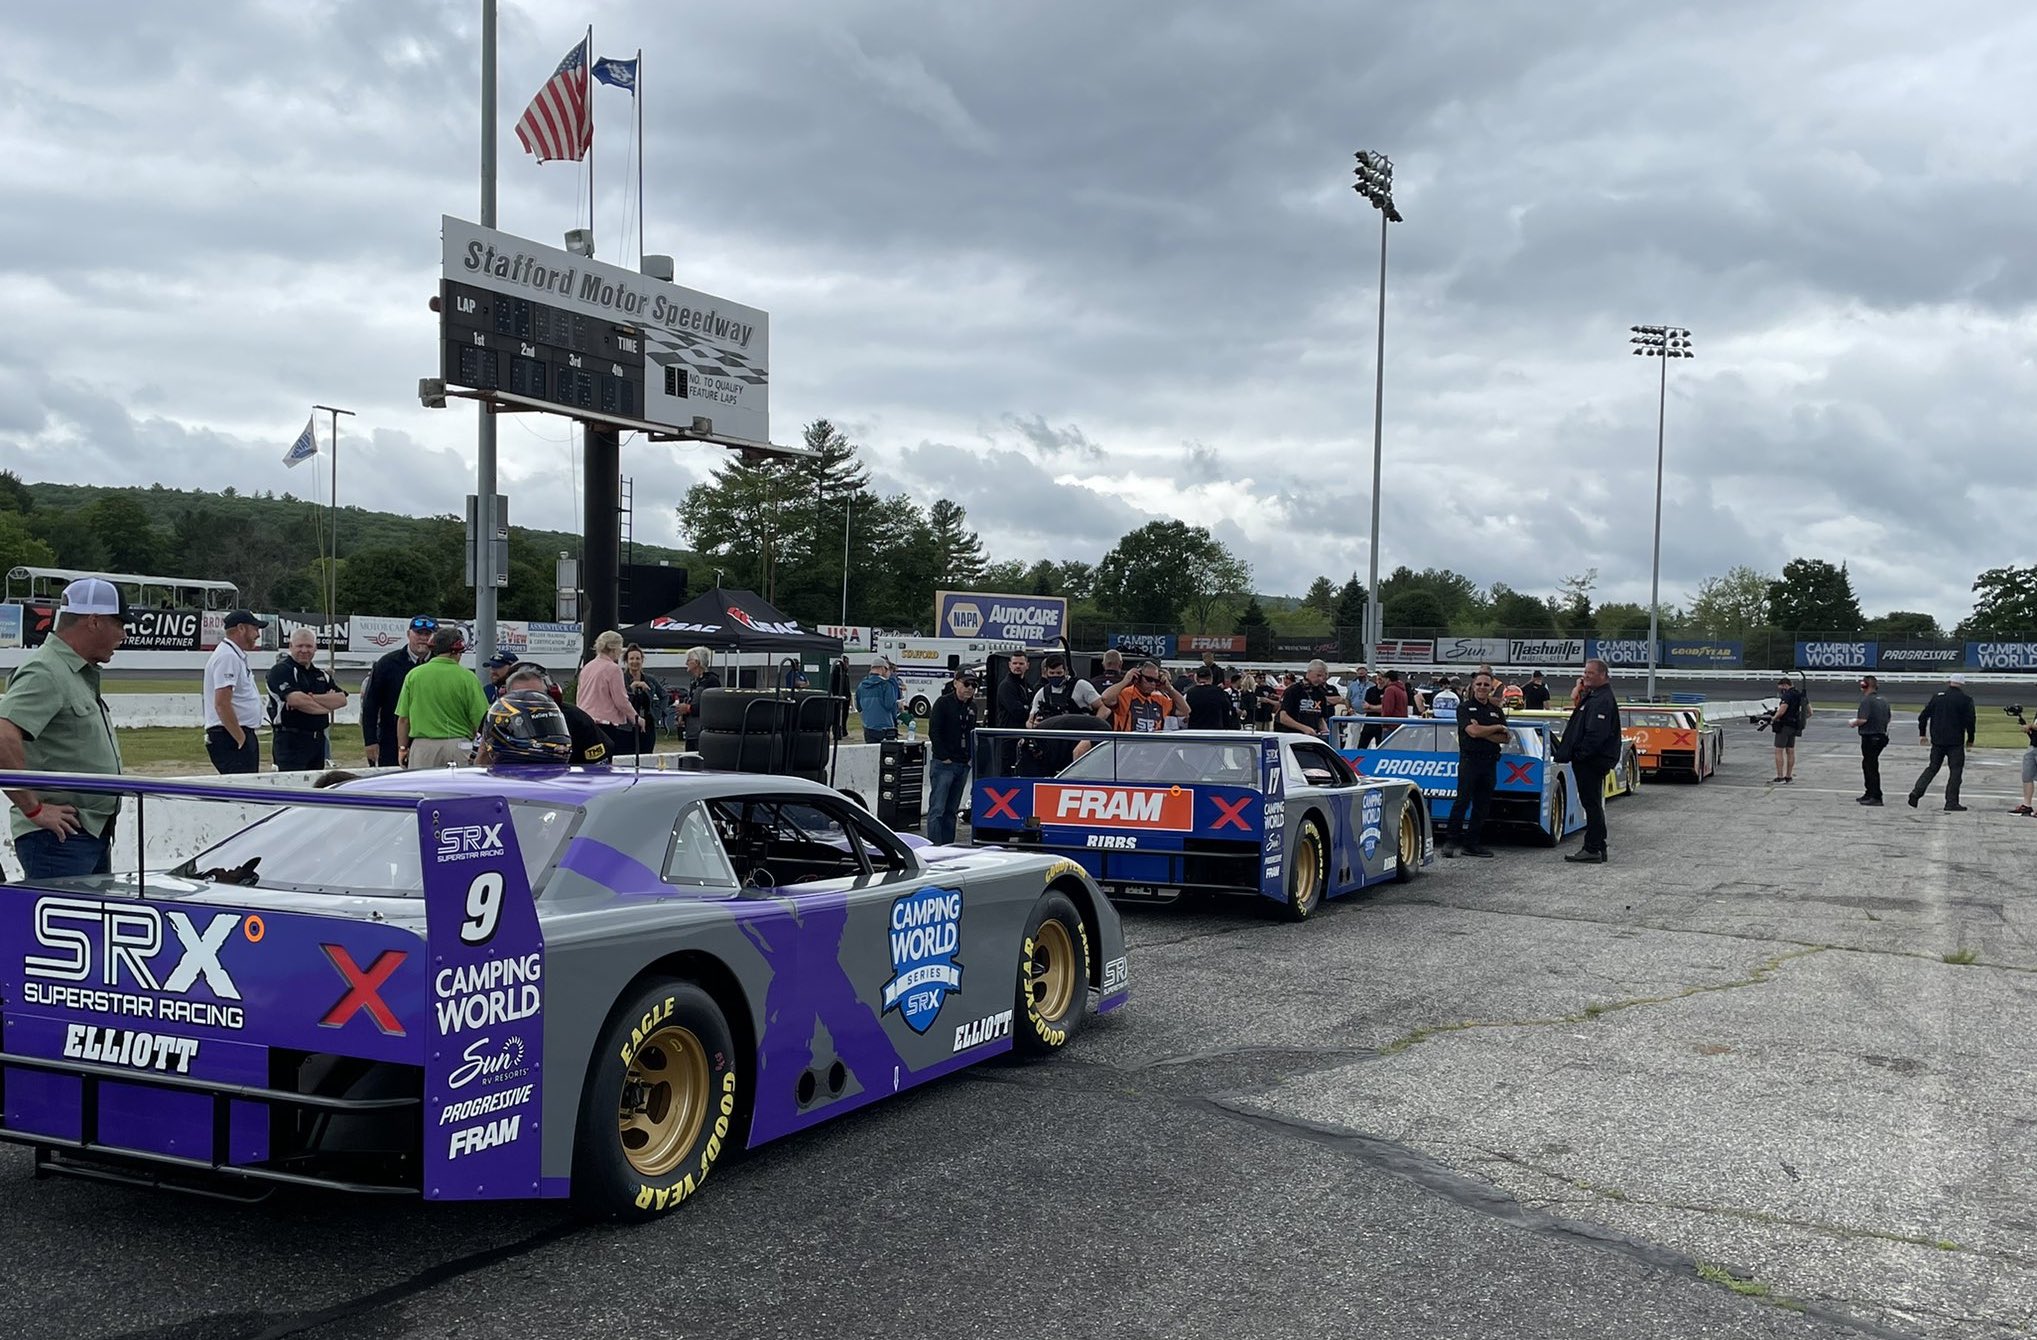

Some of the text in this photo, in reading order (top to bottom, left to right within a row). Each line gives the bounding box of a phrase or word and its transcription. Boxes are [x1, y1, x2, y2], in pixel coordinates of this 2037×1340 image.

[463, 240, 753, 349] Stafford Motor Speedway
[457, 296, 477, 314] LAP
[473, 331, 486, 347] 1st
[617, 336, 638, 354] TIME
[521, 342, 536, 358] 2nd
[568, 353, 583, 368] 3rd
[611, 363, 624, 378] 4th
[689, 385, 737, 405] FEATURE LAPS
[704, 377, 714, 388] TO
[715, 379, 744, 395] QUALIFY
[123, 613, 197, 636] ACING
[529, 623, 568, 632] ASNUNTUCK
[654, 622, 722, 633] USAC
[748, 620, 805, 635] USAC
[953, 611, 979, 628] NAPA
[506, 631, 528, 644] VIEW
[1002, 624, 1045, 640] CENTER
[121, 636, 194, 647] TREAM PARTNER
[1117, 634, 1166, 650] CAMPING
[1190, 637, 1233, 650] FRAM
[1446, 639, 1487, 658] Sun
[1597, 640, 1649, 651] CAMPING
[1806, 642, 1866, 654] CAMPING
[1597, 651, 1650, 662] WORLD
[1671, 646, 1731, 657] GOODYEAR
[1806, 654, 1866, 666] WORLD
[1881, 650, 1959, 660] PROGRESSIVE
[1977, 654, 2037, 668] WORLD
[1299, 698, 1322, 710] SRX
[1135, 717, 1162, 732] SRX
[1373, 758, 1459, 778] PROGRESS
[1267, 767, 1281, 795] 17
[1056, 788, 1165, 823] FRAM
[1263, 800, 1285, 816] CAMPING
[1362, 793, 1383, 808] CAMPING
[1263, 813, 1285, 830] WORLD
[1361, 807, 1381, 825] WORLD
[437, 823, 504, 855] SRX
[437, 848, 504, 863] SUPERSTAR RACING
[1044, 860, 1087, 883] GOODYEAR
[460, 871, 505, 943] 9
[892, 893, 961, 931] CAMPING
[24, 896, 242, 1001] SRX
[891, 922, 958, 966] WORLD
[1078, 921, 1091, 979] EAGLE
[435, 953, 541, 999] CAMPING
[907, 967, 942, 986] SERIES
[1103, 955, 1128, 988] SR
[24, 982, 244, 1029] SUPERSTAR RACING
[435, 984, 541, 1036] WORLD
[906, 988, 941, 1016] SRX
[620, 996, 676, 1068] EAGLE
[952, 1009, 1013, 1052] ELLIOTT
[63, 1023, 199, 1075] ELLIOTT
[448, 1037, 513, 1090] Sun
[481, 1067, 530, 1086] RV RESORTS
[439, 1083, 534, 1127] PROGRESSIVE
[448, 1114, 522, 1161] FRAM
[634, 1071, 736, 1211] GOODYEAR
